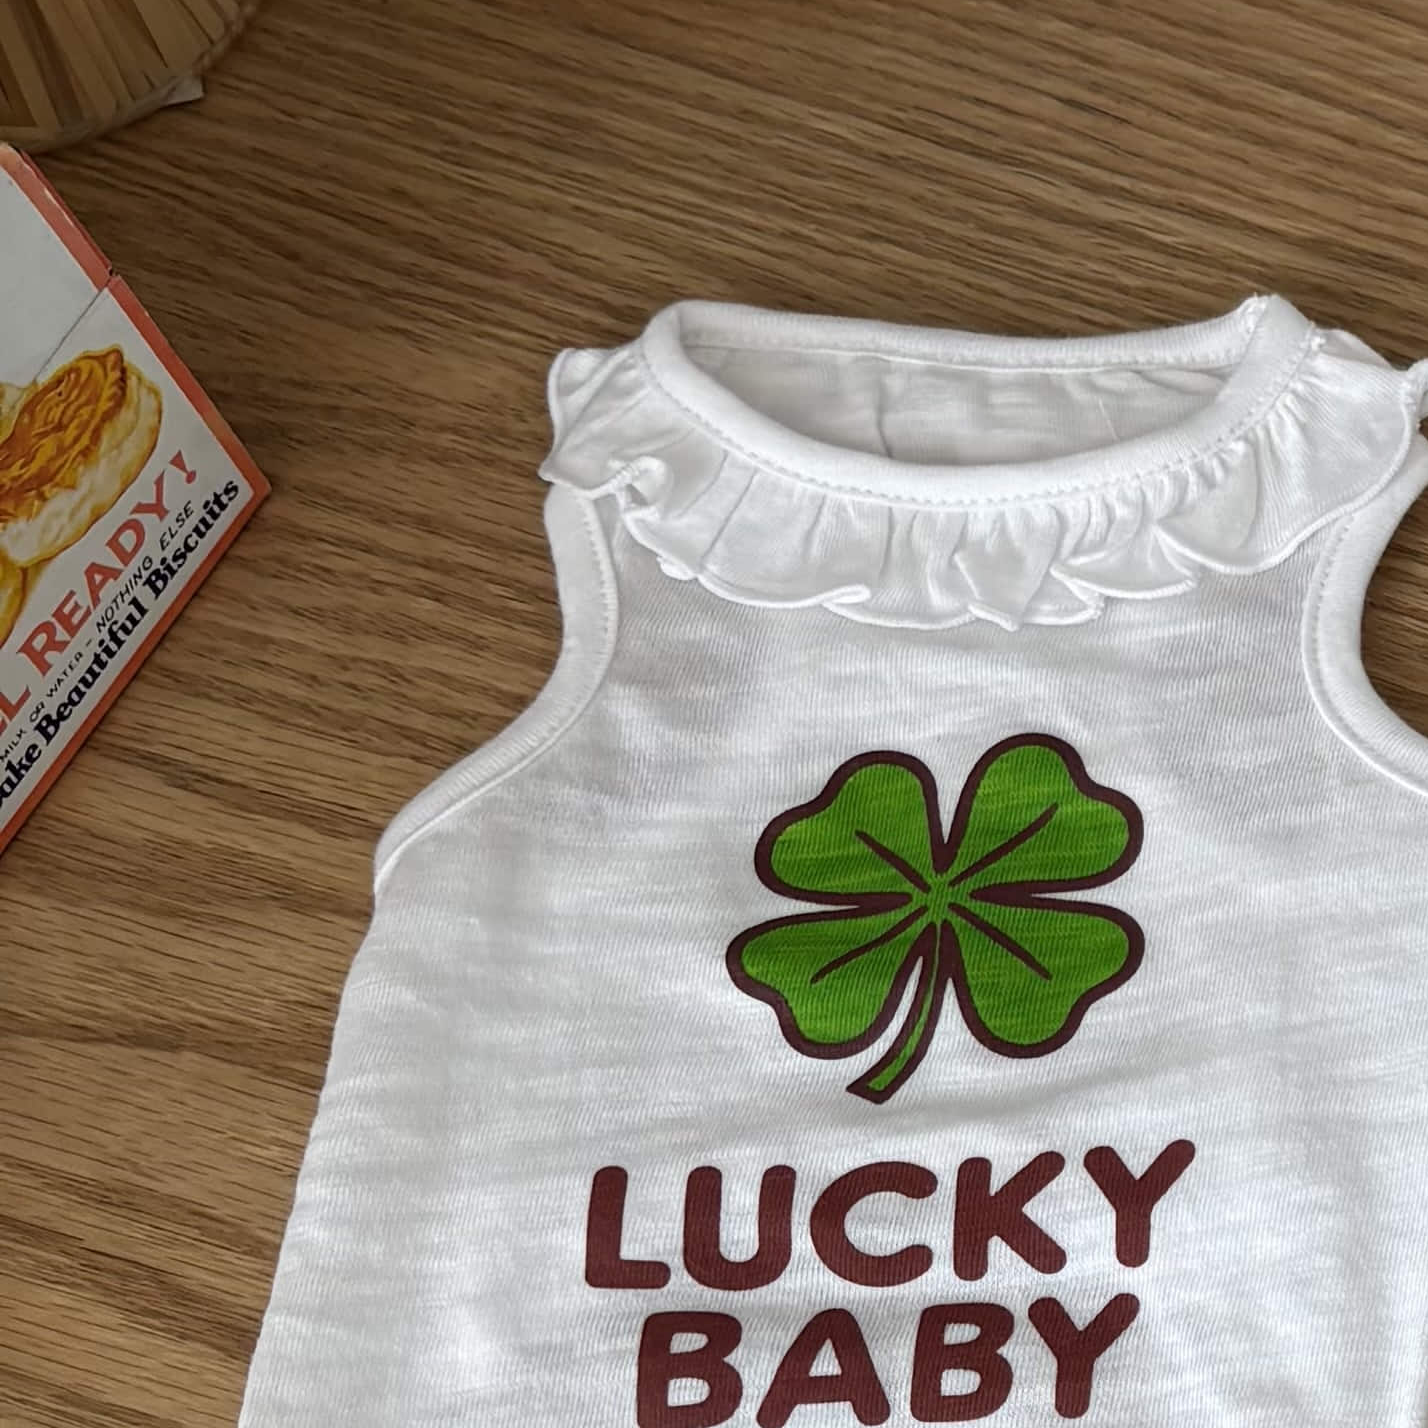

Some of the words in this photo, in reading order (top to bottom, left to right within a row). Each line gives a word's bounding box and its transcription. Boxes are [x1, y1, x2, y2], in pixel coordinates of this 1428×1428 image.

[0, 739, 43, 810] ake
[33, 596, 150, 748] Beautiful
[142, 478, 241, 603] Biscuits
[14, 449, 198, 679] READY!
[45, 649, 84, 699] WATER
[96, 554, 155, 637] NOTHING
[158, 499, 196, 551] ELSE
[584, 1139, 1196, 1292] LUCKY
